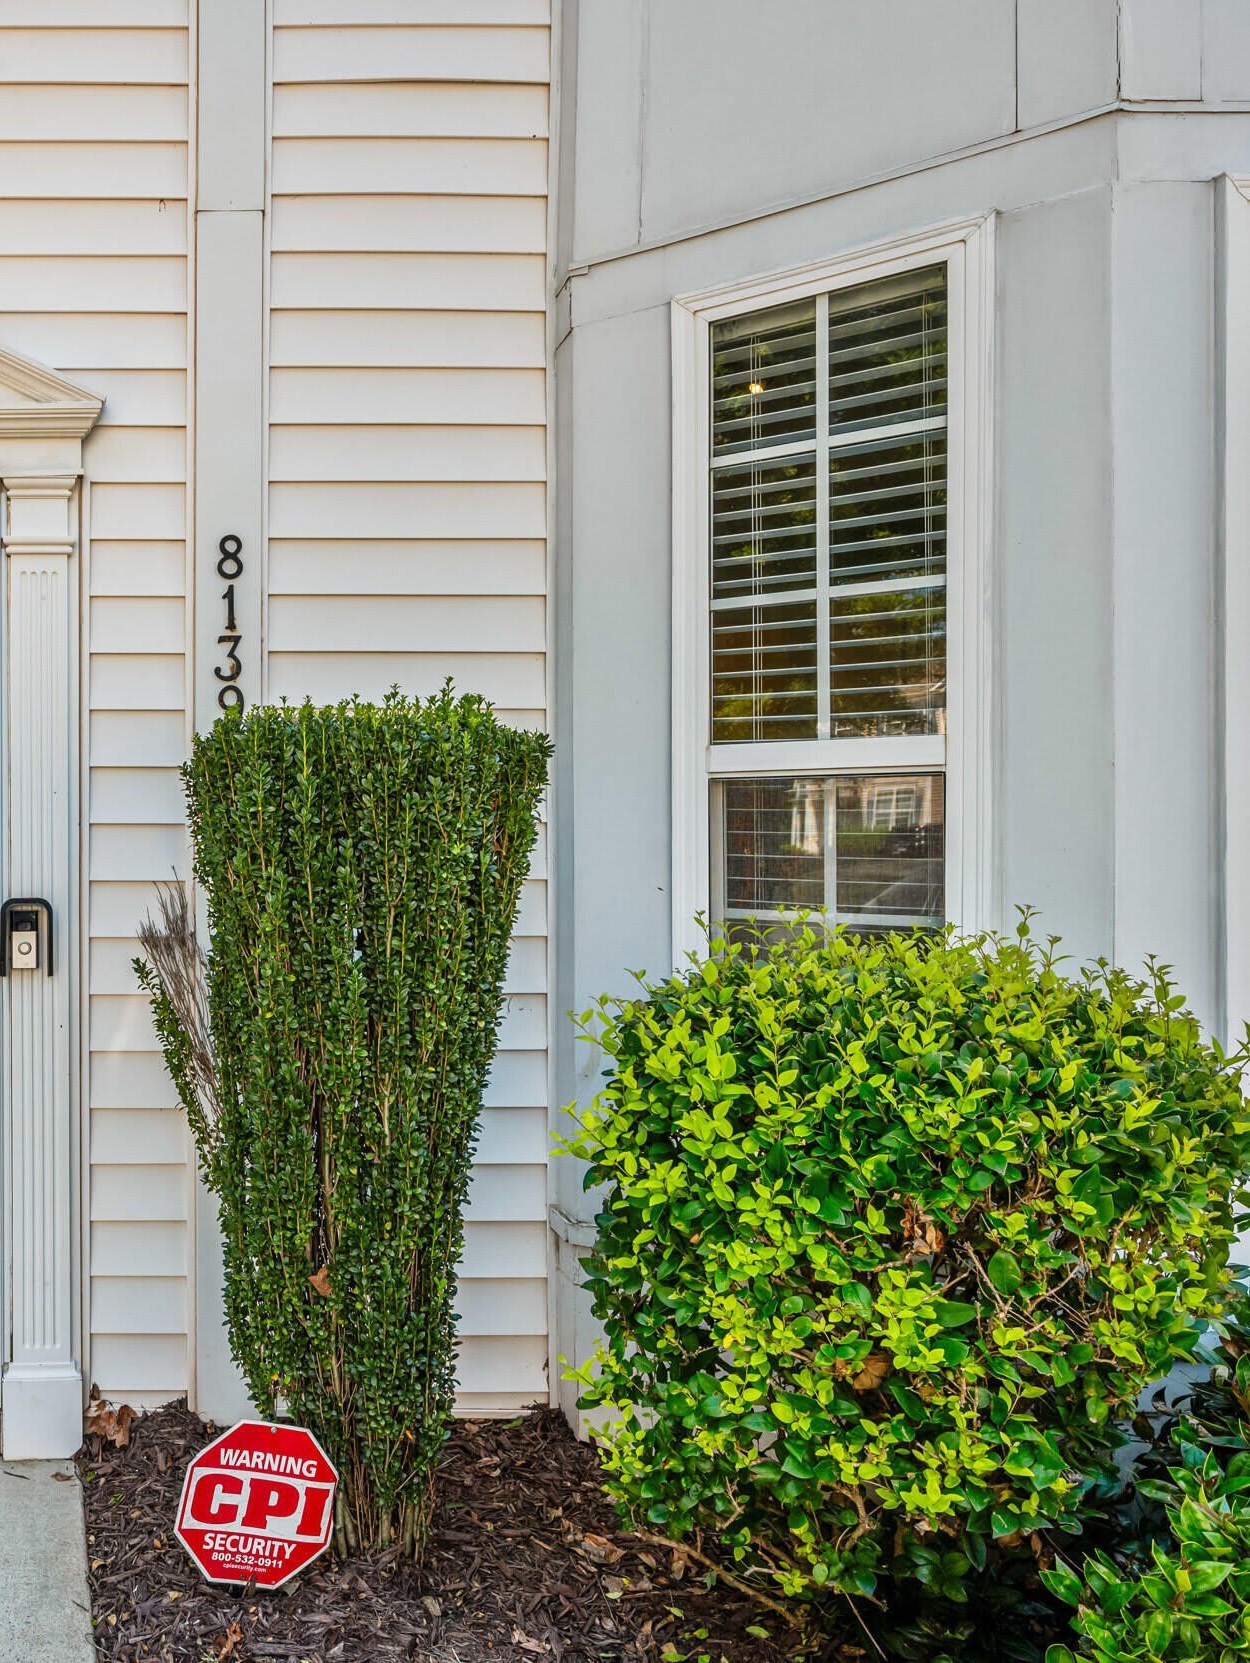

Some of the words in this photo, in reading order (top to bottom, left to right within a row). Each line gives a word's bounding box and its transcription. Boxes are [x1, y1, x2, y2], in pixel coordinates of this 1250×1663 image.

[214, 534, 244, 716] 8139
[219, 1448, 318, 1478] WARNING
[190, 1473, 331, 1537] CPI
[202, 1532, 297, 1560] SECURITY
[211, 1552, 283, 1569] 800-532-0911
[222, 1562, 267, 1573] cpisecurity.com
